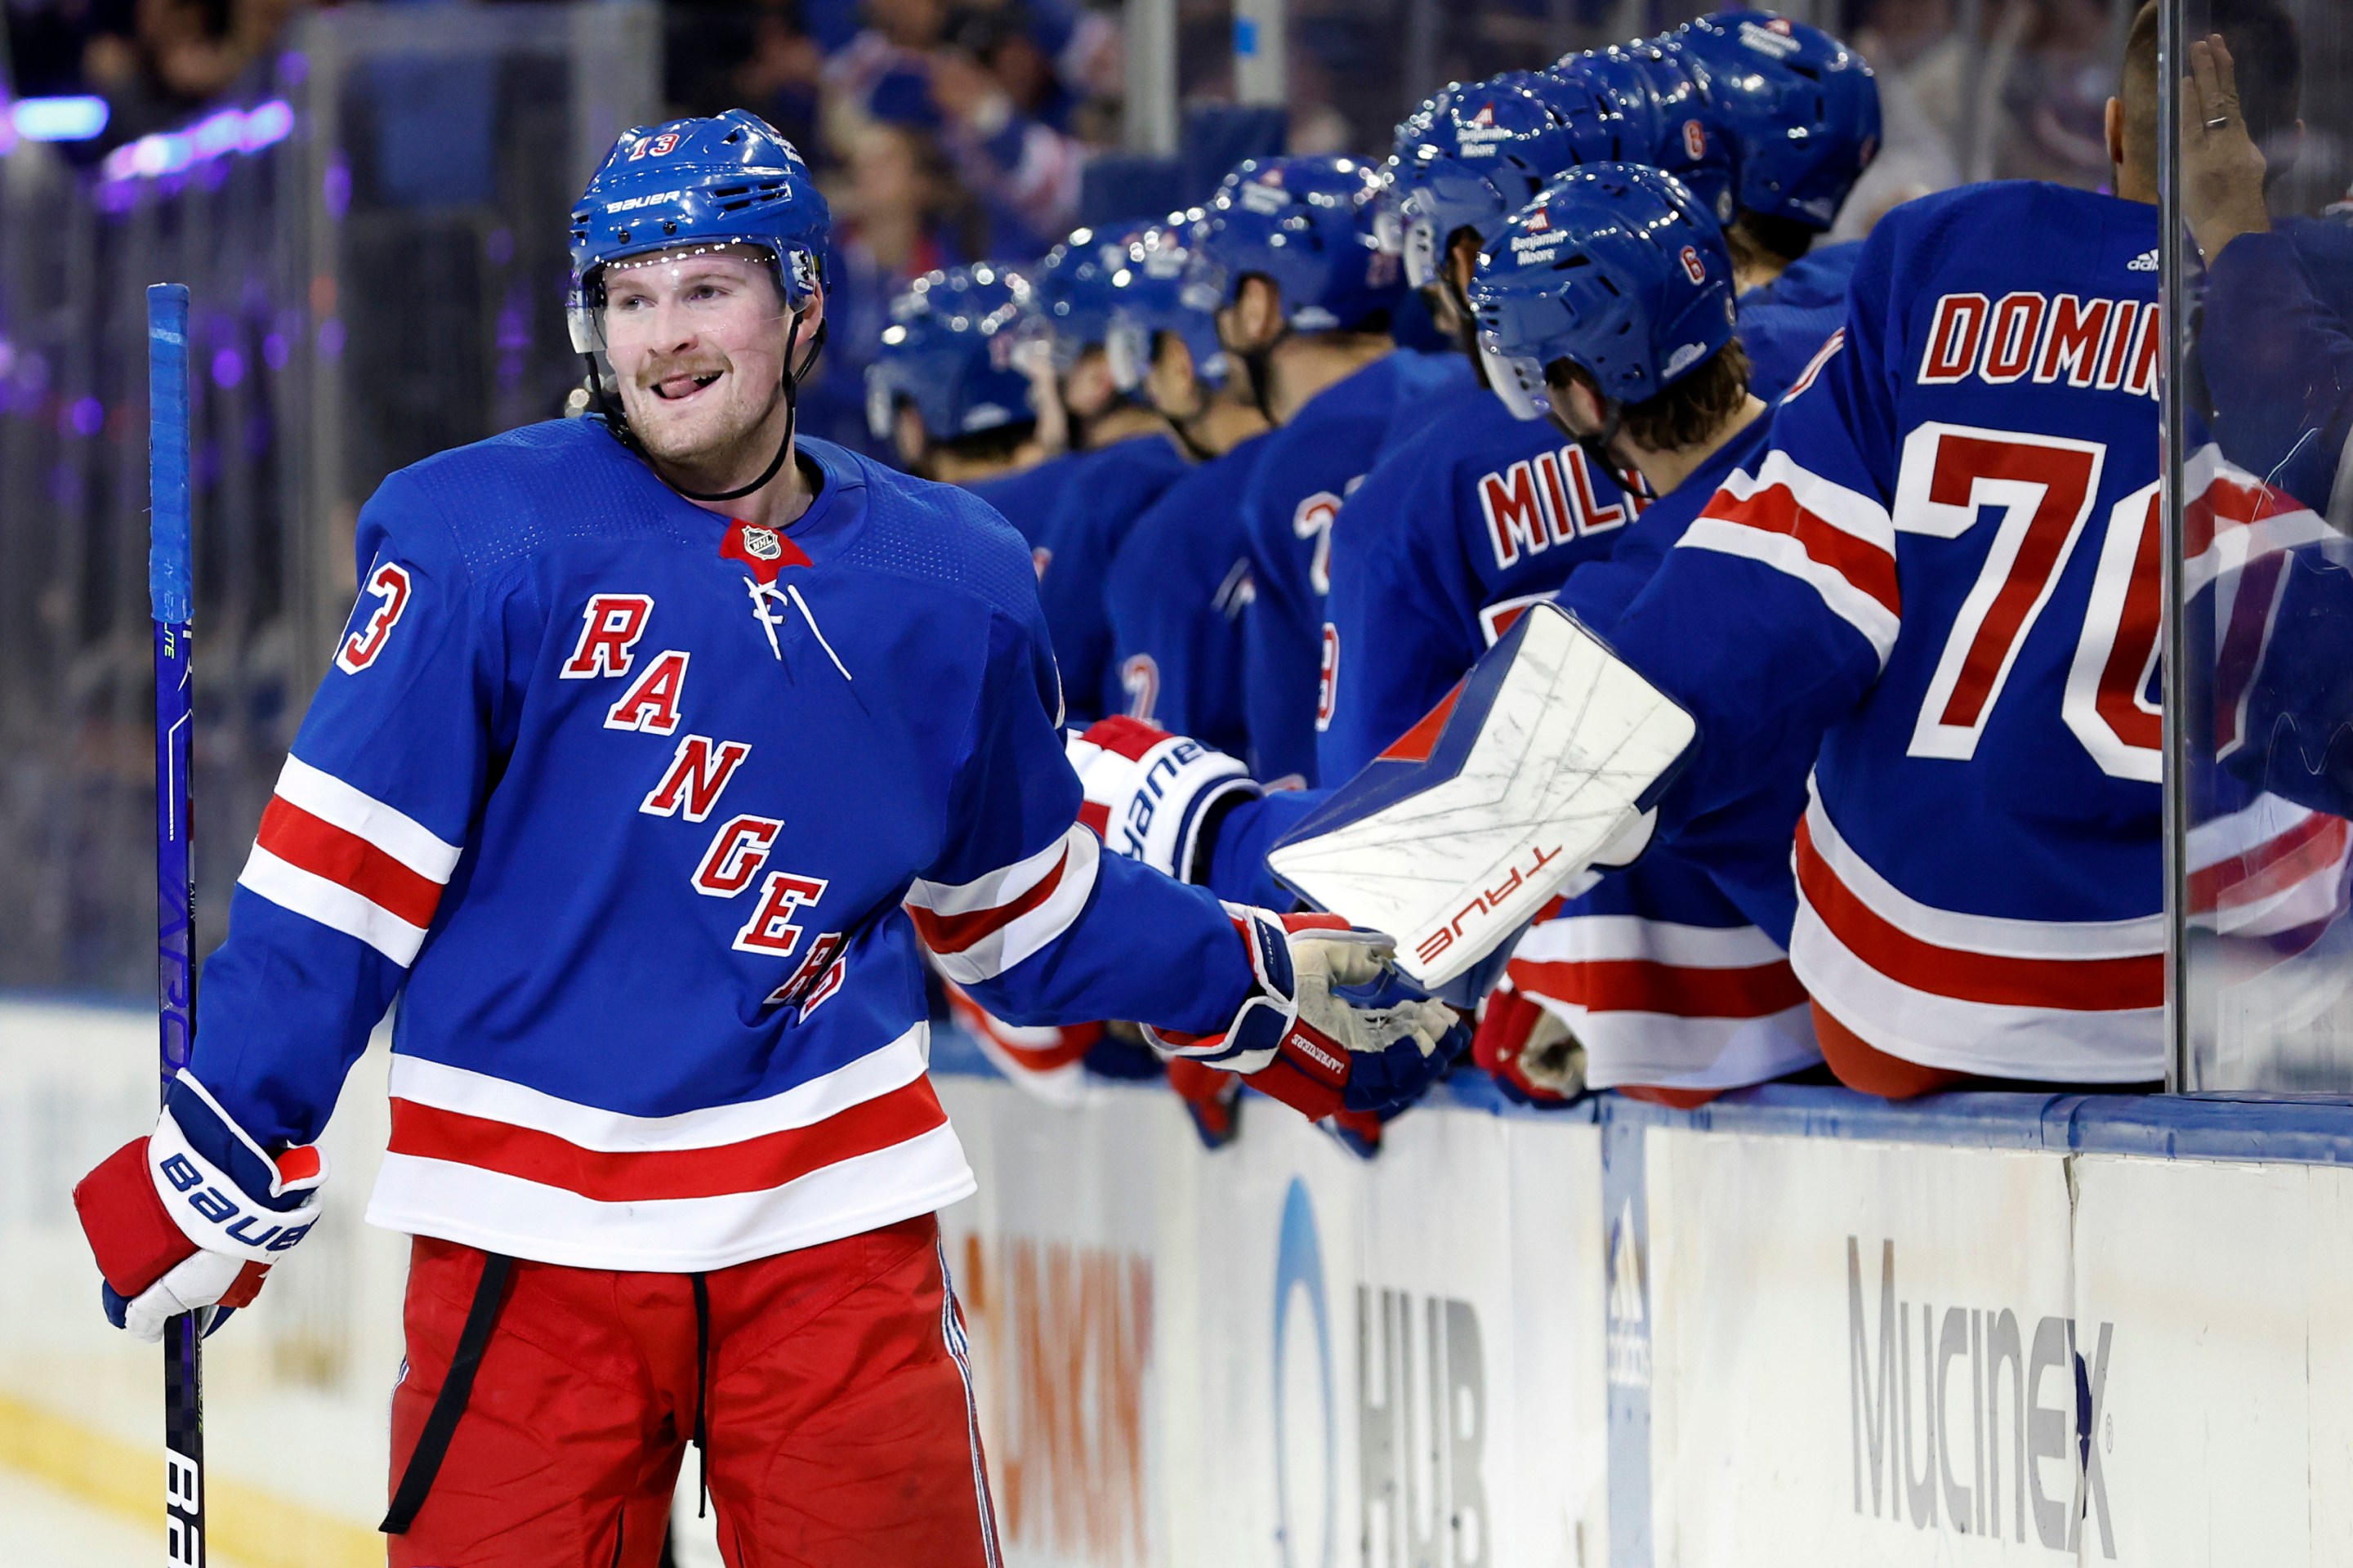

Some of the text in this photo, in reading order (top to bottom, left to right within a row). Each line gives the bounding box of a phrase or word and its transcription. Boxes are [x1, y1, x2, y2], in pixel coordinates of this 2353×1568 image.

[628, 133, 680, 162] 13
[1511, 230, 1565, 252] Benjamin
[1516, 248, 1555, 266] Moore
[752, 536, 773, 551] NHL
[333, 552, 412, 676] 3
[1416, 845, 1563, 965] TRUE
[160, 1153, 322, 1252] BAUE
